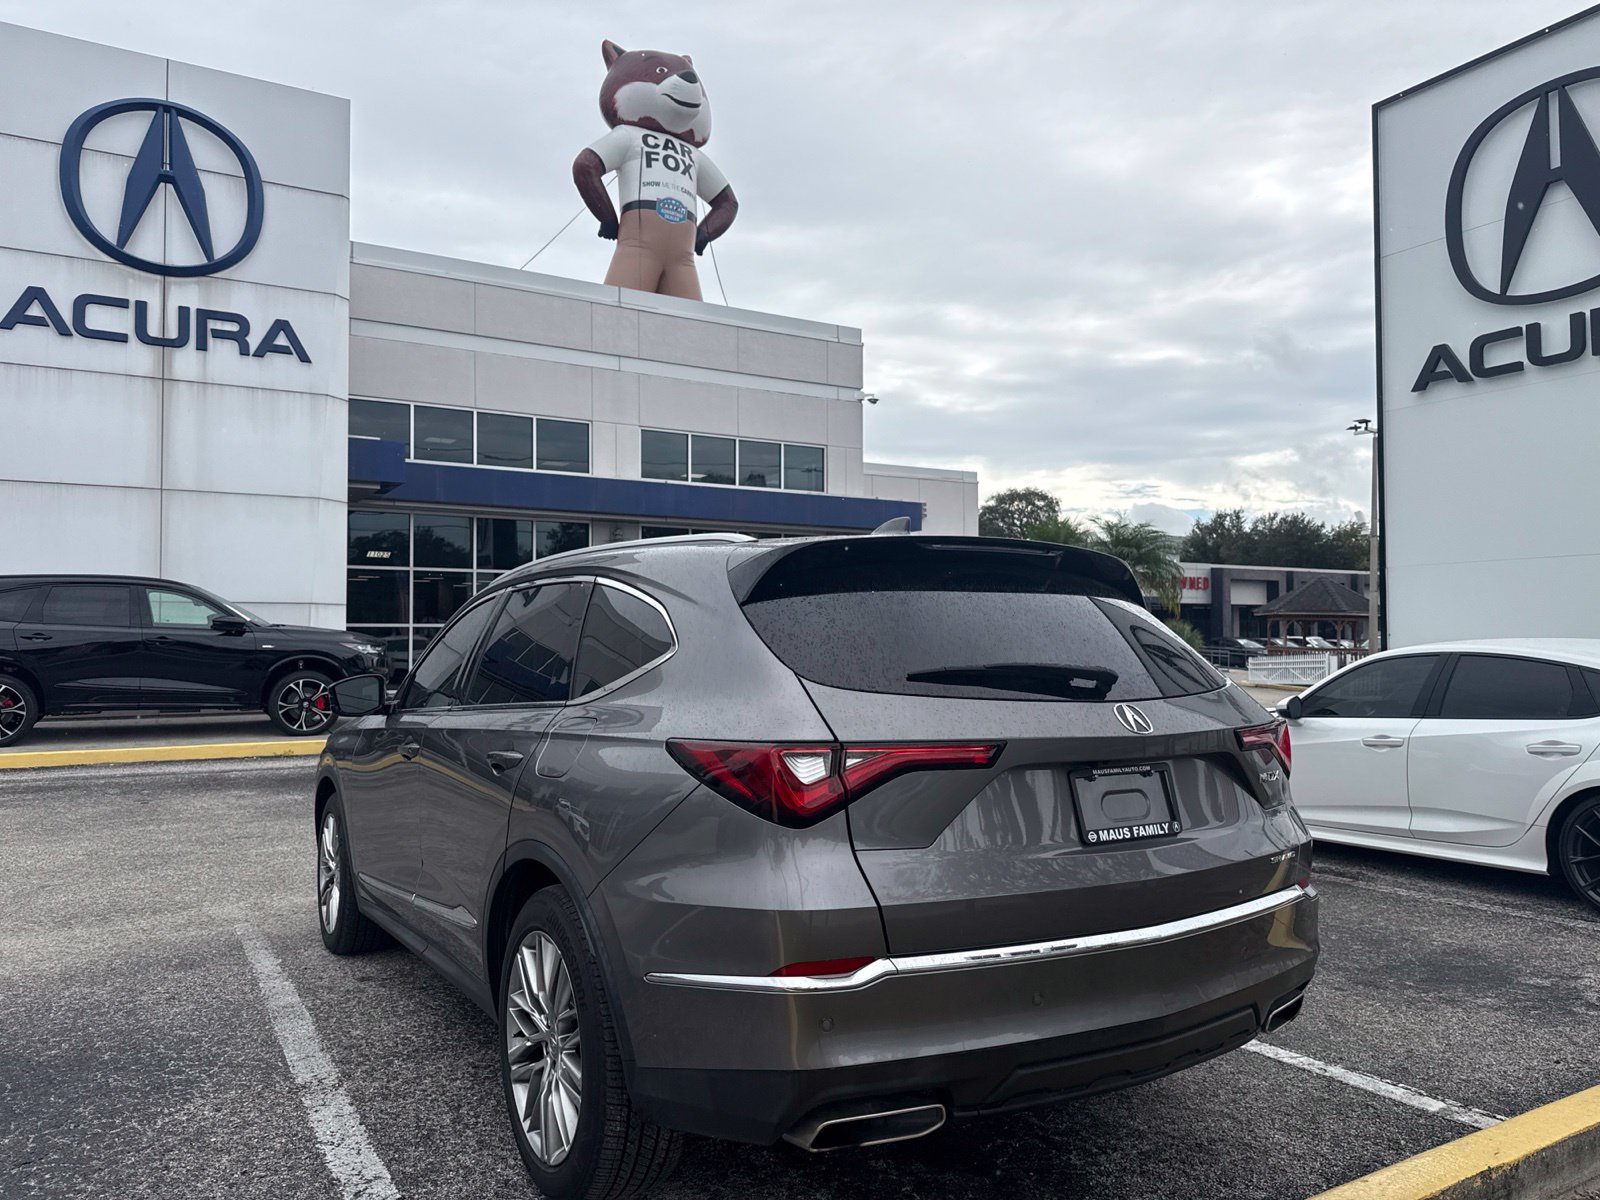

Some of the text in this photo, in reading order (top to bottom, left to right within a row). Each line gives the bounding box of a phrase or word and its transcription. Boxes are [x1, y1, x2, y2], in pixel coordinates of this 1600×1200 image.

[642, 133, 695, 164] CAR
[645, 151, 693, 182] FOX
[0, 285, 312, 364] ACURA
[1411, 307, 1600, 393] ACU
[1172, 576, 1210, 590] WNED
[1092, 765, 1151, 775] MAUSFAMILYAUTO.COM
[1099, 822, 1170, 842] MAUS FAMILY
